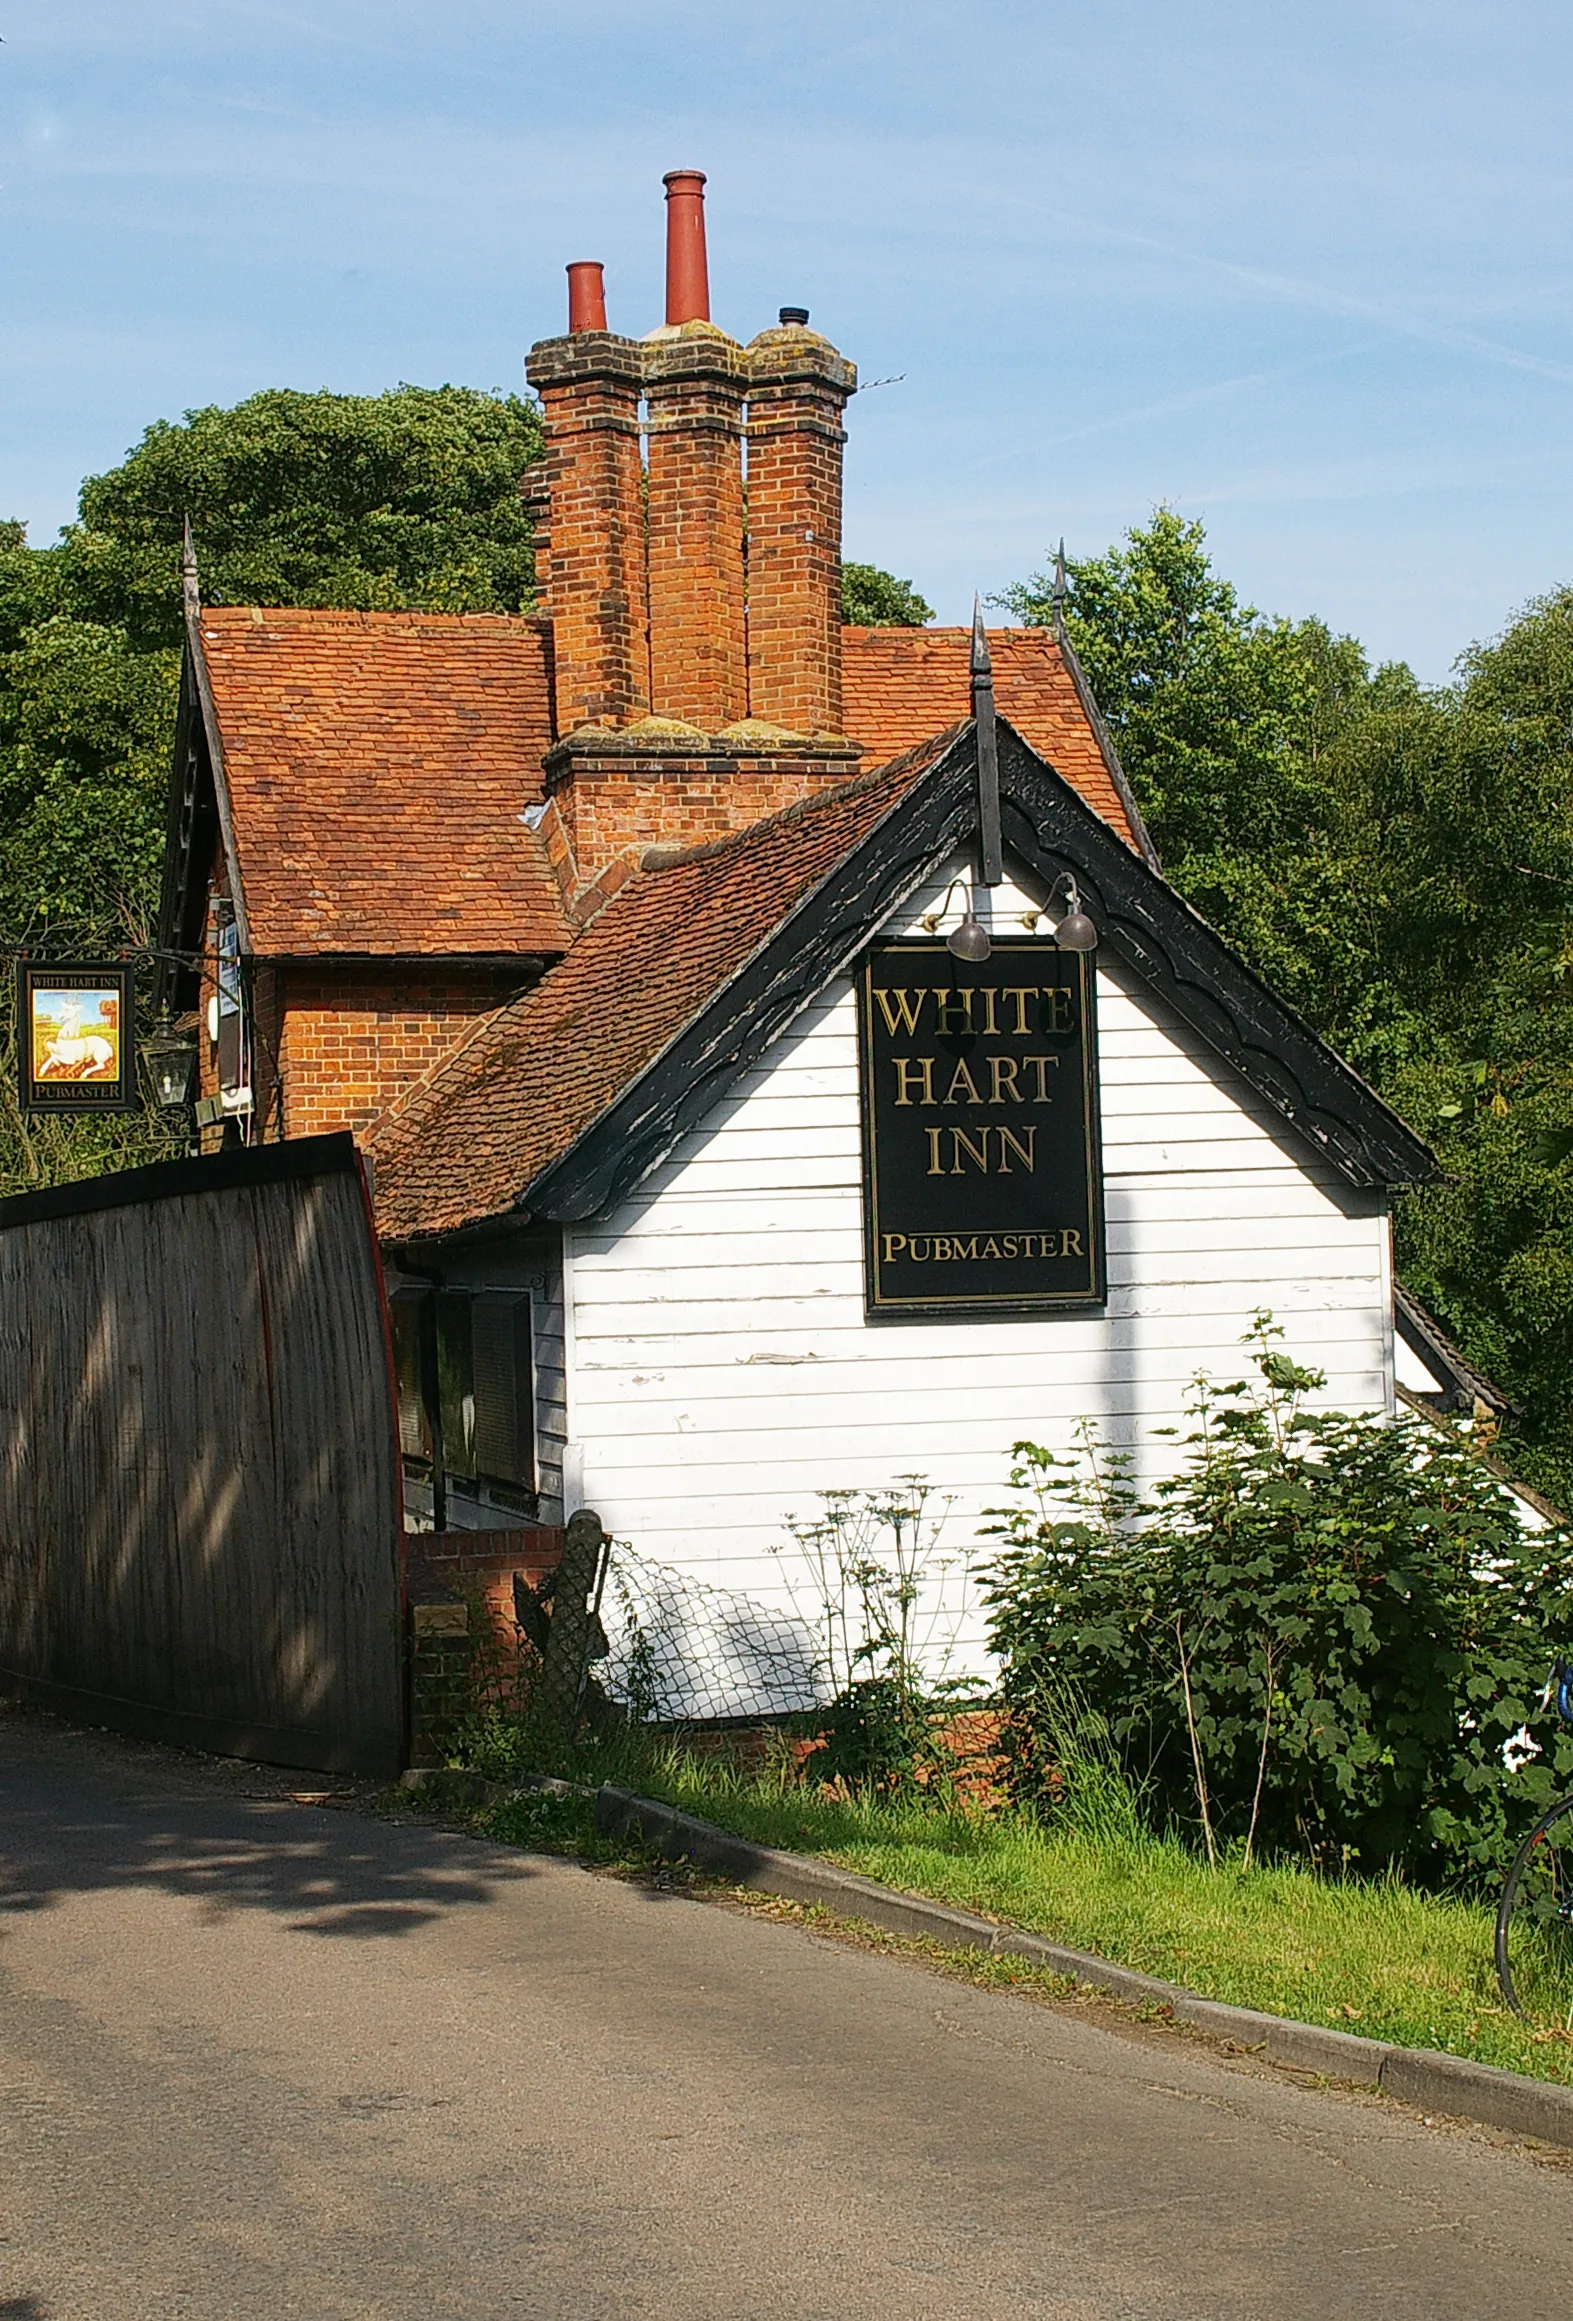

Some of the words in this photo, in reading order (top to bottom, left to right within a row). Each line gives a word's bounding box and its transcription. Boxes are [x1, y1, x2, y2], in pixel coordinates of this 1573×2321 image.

[33, 977, 69, 988] WHITE
[70, 977, 97, 988] HART
[100, 977, 119, 988] INN
[872, 987, 1074, 1037] WHITE
[35, 1084, 120, 1098] PUBMASTER
[891, 1057, 1058, 1105] HART
[924, 1126, 1037, 1175] INN
[882, 1229, 1084, 1263] PUBMASTER
